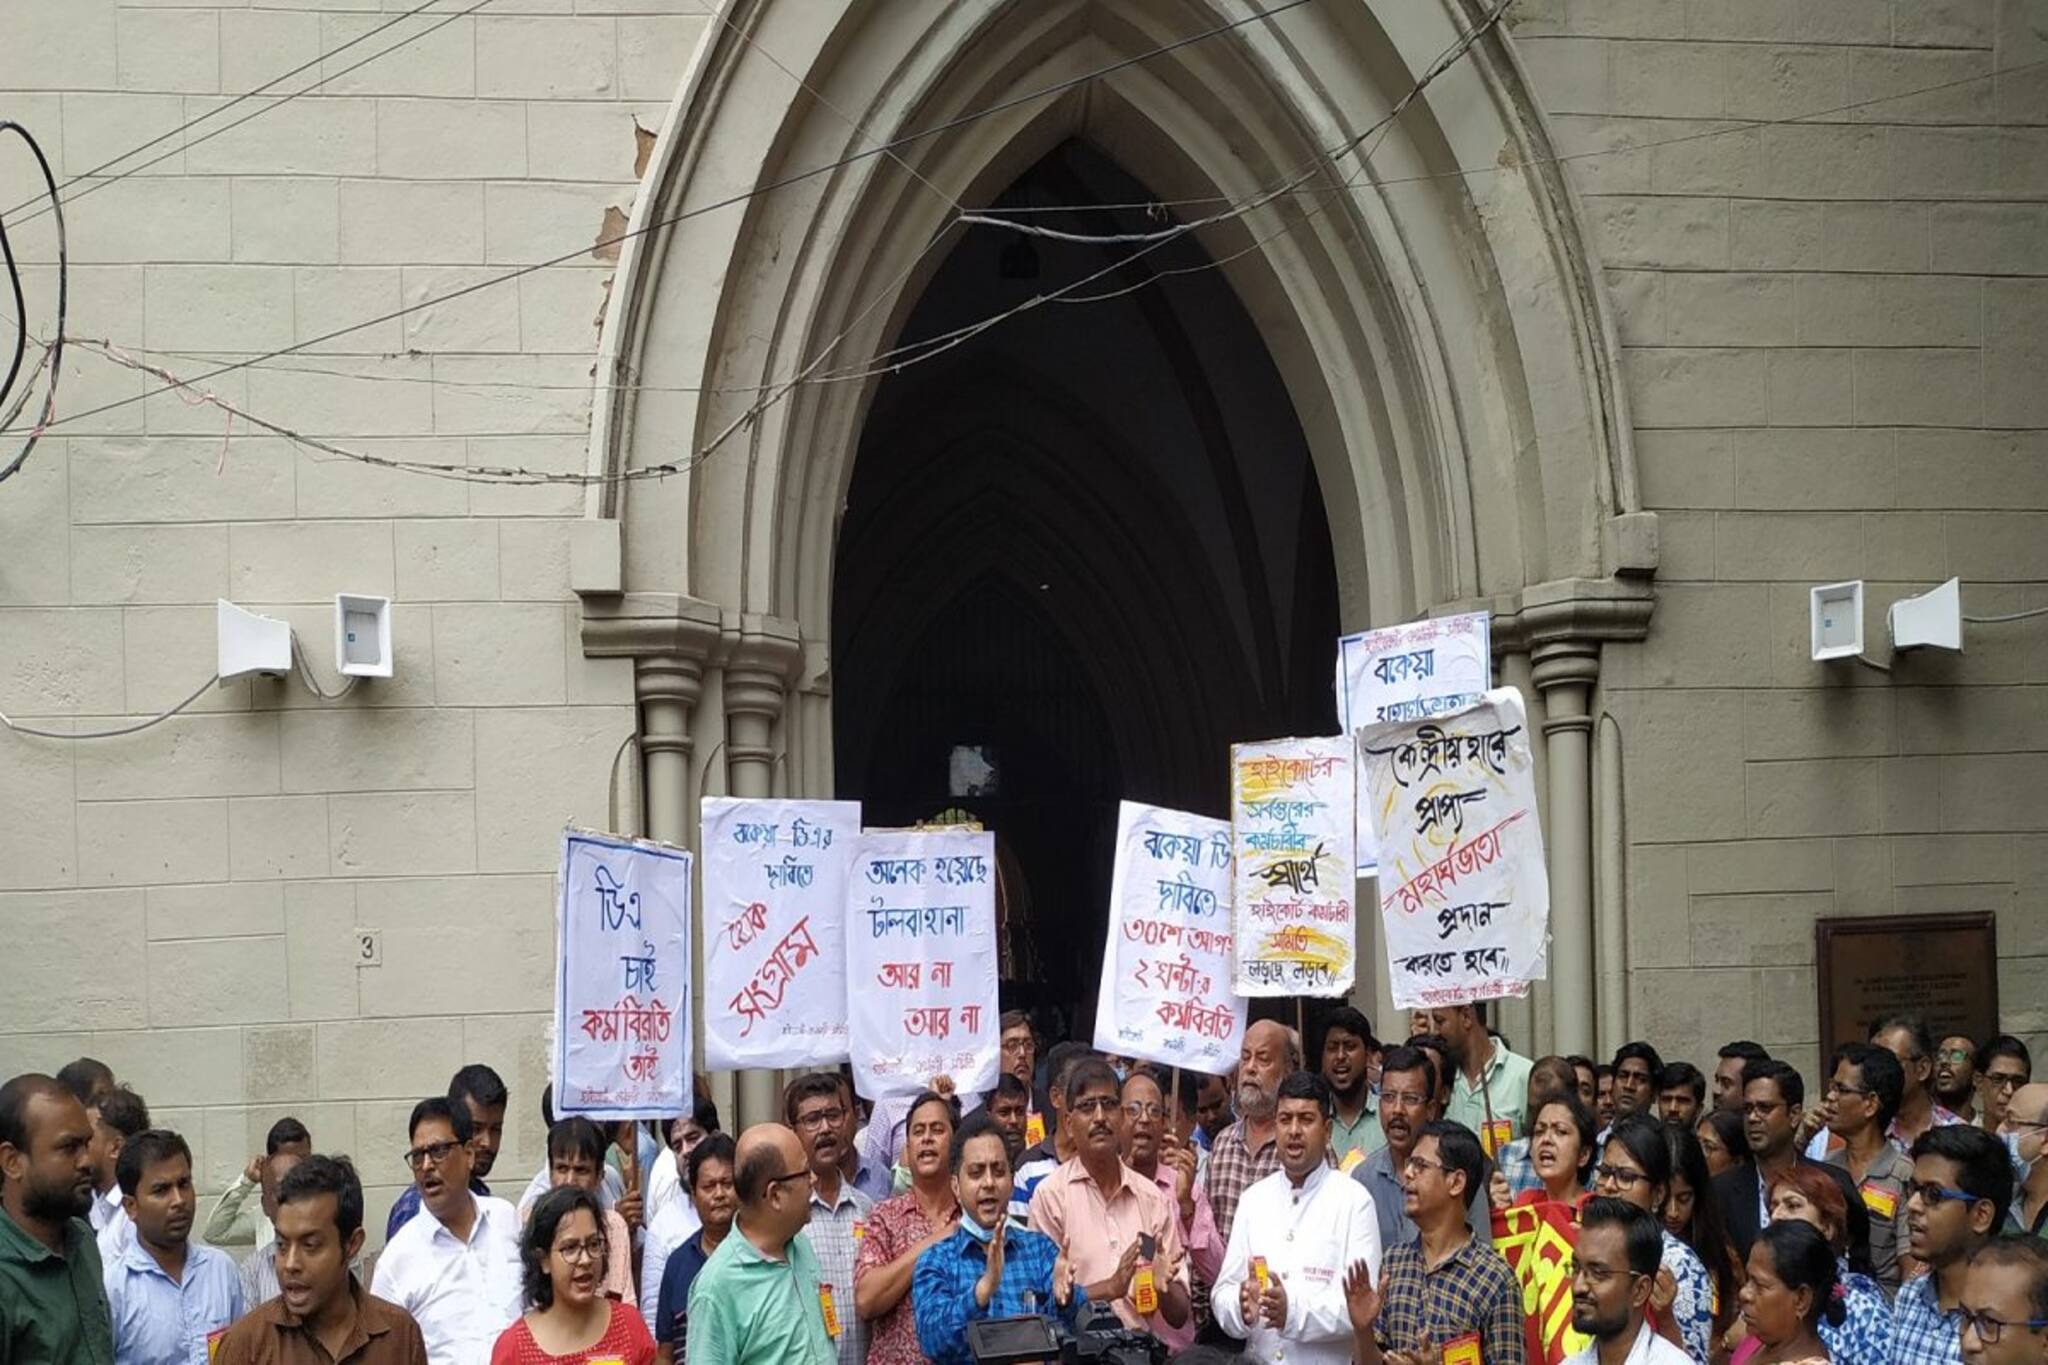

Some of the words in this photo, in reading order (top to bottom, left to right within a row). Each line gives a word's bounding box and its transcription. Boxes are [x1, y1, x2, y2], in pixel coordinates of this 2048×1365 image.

[1374, 648, 1435, 685] বকেয়া
[1465, 725, 1521, 775] হারে
[1415, 788, 1487, 835] প্রাপ্য
[733, 823, 779, 849] বকেয়া
[792, 817, 833, 850] ডিএর
[1145, 830, 1201, 867] বকেয়া
[1211, 831, 1233, 869] ডি
[764, 855, 814, 890] দাবিতে
[865, 859, 928, 886] অনেক
[934, 855, 987, 885] হয়েছে
[594, 864, 643, 931] ডিএ
[1157, 870, 1217, 917] দাবিতে
[728, 902, 767, 951] হোক
[867, 895, 970, 937] টালবাহানা
[1438, 901, 1511, 939] প্রদান
[362, 936, 374, 959] 3
[1187, 927, 1233, 957] আগ
[621, 941, 658, 993] চাই
[728, 915, 819, 1038] সংগ্রাম
[877, 963, 921, 989] আর
[931, 962, 954, 988] না
[1393, 951, 1457, 977] করতে
[904, 1007, 951, 1040] আর
[960, 1005, 982, 1034] না
[623, 1043, 660, 1083] তাই
